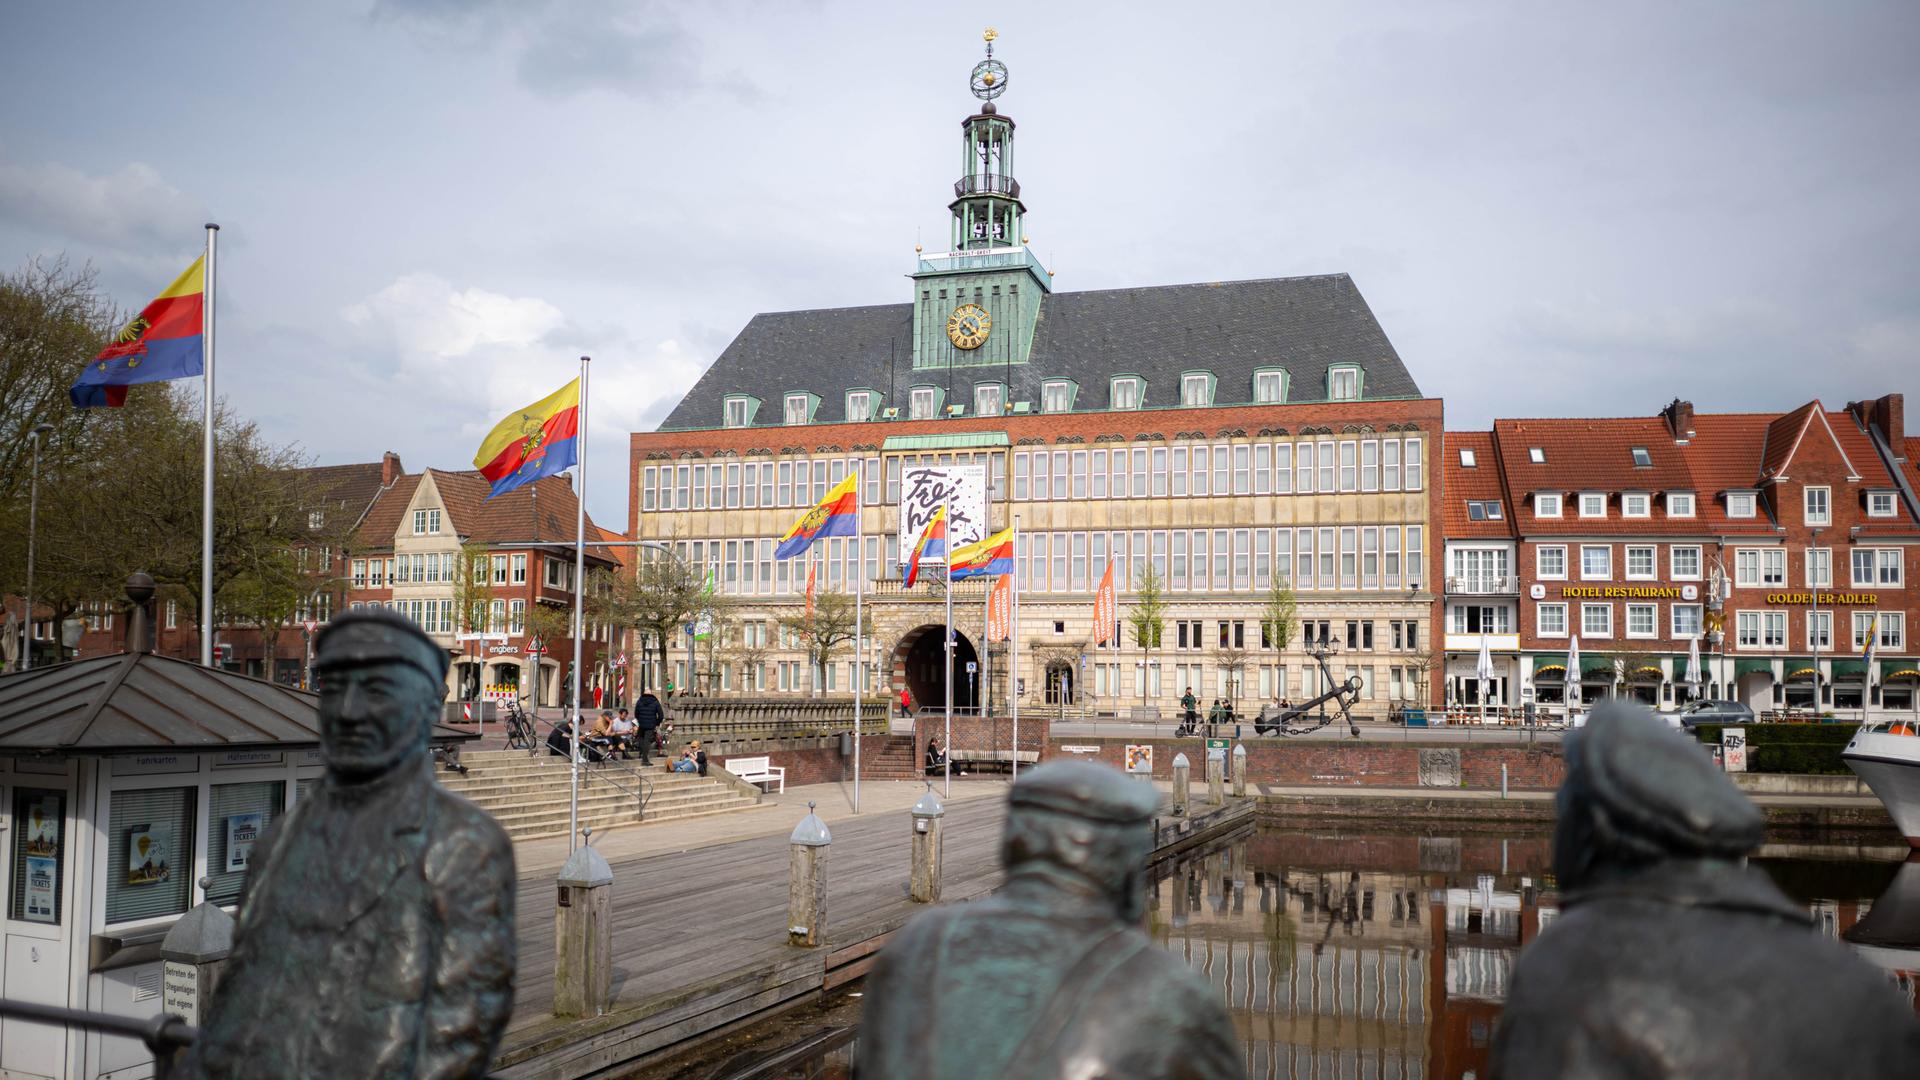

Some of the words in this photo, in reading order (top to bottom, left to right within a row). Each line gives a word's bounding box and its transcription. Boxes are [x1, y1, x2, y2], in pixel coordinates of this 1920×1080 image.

[1562, 587, 1602, 597] HOTEL
[1605, 587, 1681, 597] RESTAURANT
[1837, 593, 1878, 604] ADLER
[489, 645, 518, 654] engbers
[137, 755, 177, 765] Fahrkarten
[233, 832, 257, 841] TICKETS
[31, 879, 51, 889] TICKETS
[165, 966, 186, 978] Betreten
[187, 971, 196, 979] der
[165, 981, 196, 996] Steganlagen
[167, 998, 176, 1006] auf
[176, 1000, 193, 1010] eigene
